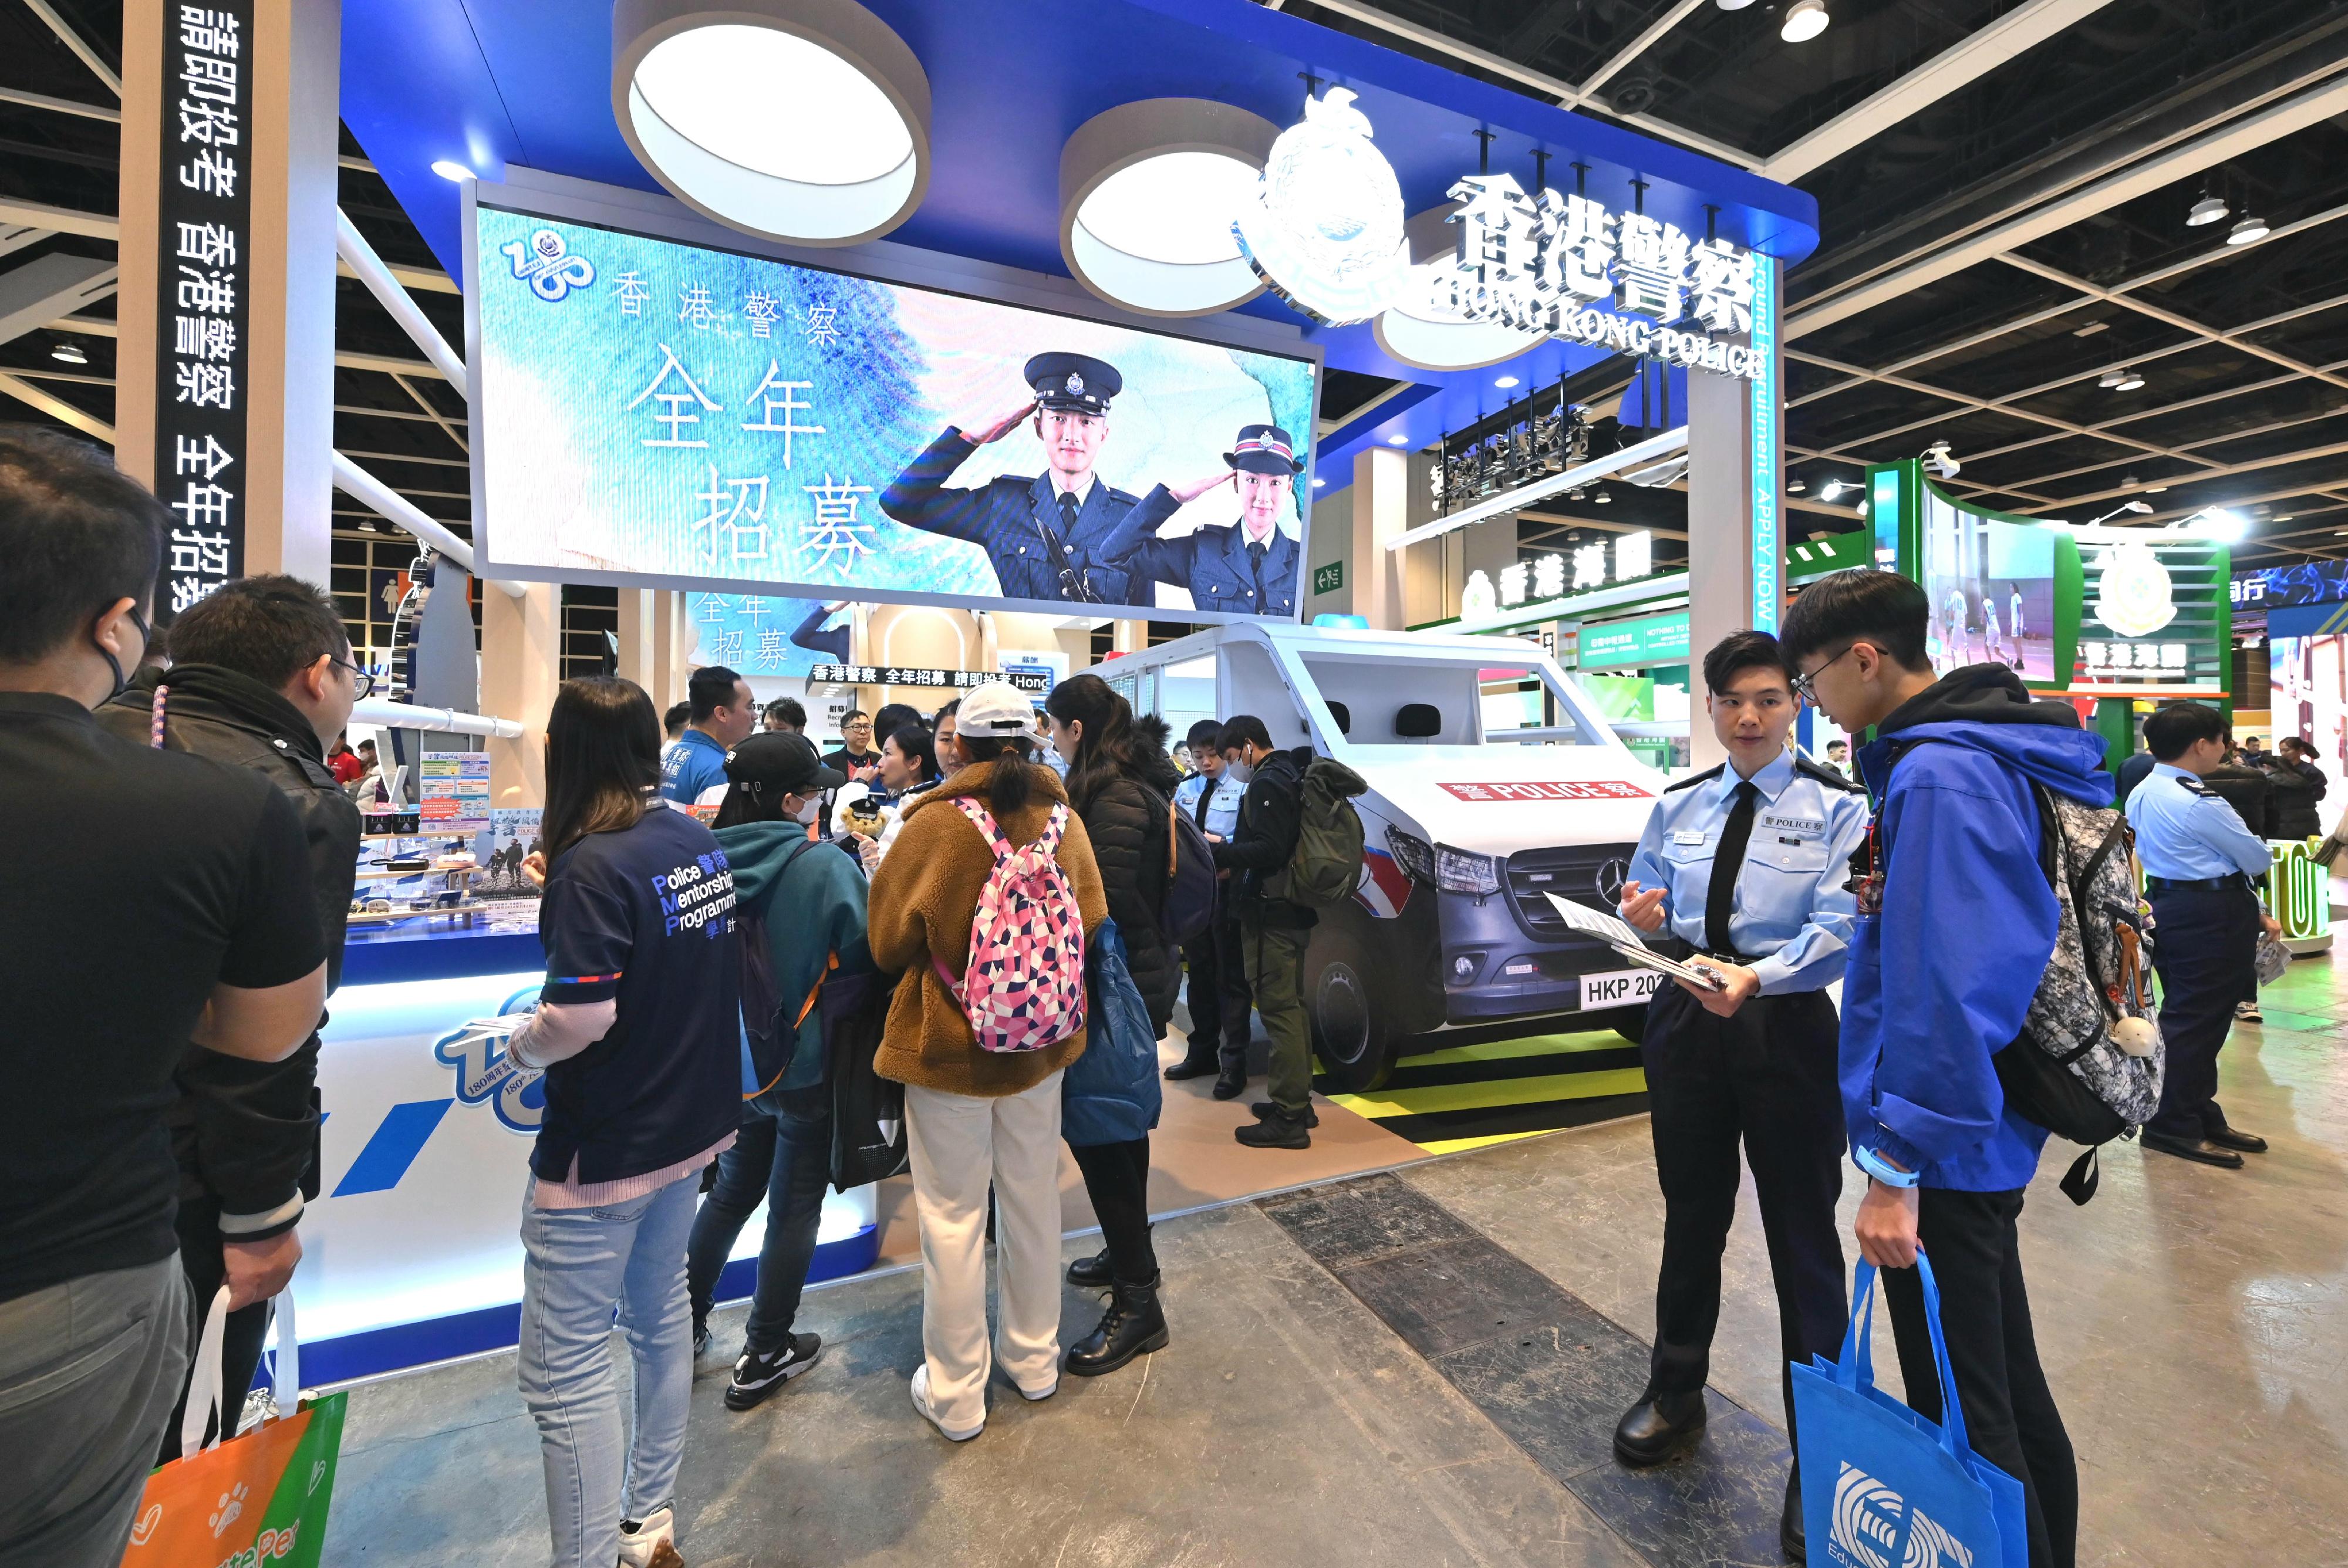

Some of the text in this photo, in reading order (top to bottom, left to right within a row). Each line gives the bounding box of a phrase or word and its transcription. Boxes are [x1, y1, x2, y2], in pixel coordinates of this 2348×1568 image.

[180, 5, 239, 198] 請即投考
[1446, 173, 1756, 334] 香港警察
[176, 221, 237, 409] 香港警察
[610, 269, 842, 348] 香港警察
[1426, 270, 1766, 379] HONG KONG POLICE
[628, 342, 827, 471] 全年
[691, 463, 878, 577] 招募
[1757, 488, 1772, 555] APPLY
[1757, 564, 1773, 621] NOW
[711, 626, 788, 670] 招募
[1647, 626, 1674, 637] NOTHING
[812, 665, 876, 683] 香港警察
[885, 669, 946, 686] 全年招募
[1449, 781, 1642, 801] 警 POLICE 察
[1765, 817, 1823, 831] 警 POLICE 察
[651, 865, 701, 896] Police
[660, 870, 734, 916] Mentorship
[1588, 978, 1630, 1003] HKP
[505, 1075, 527, 1095] 180th
